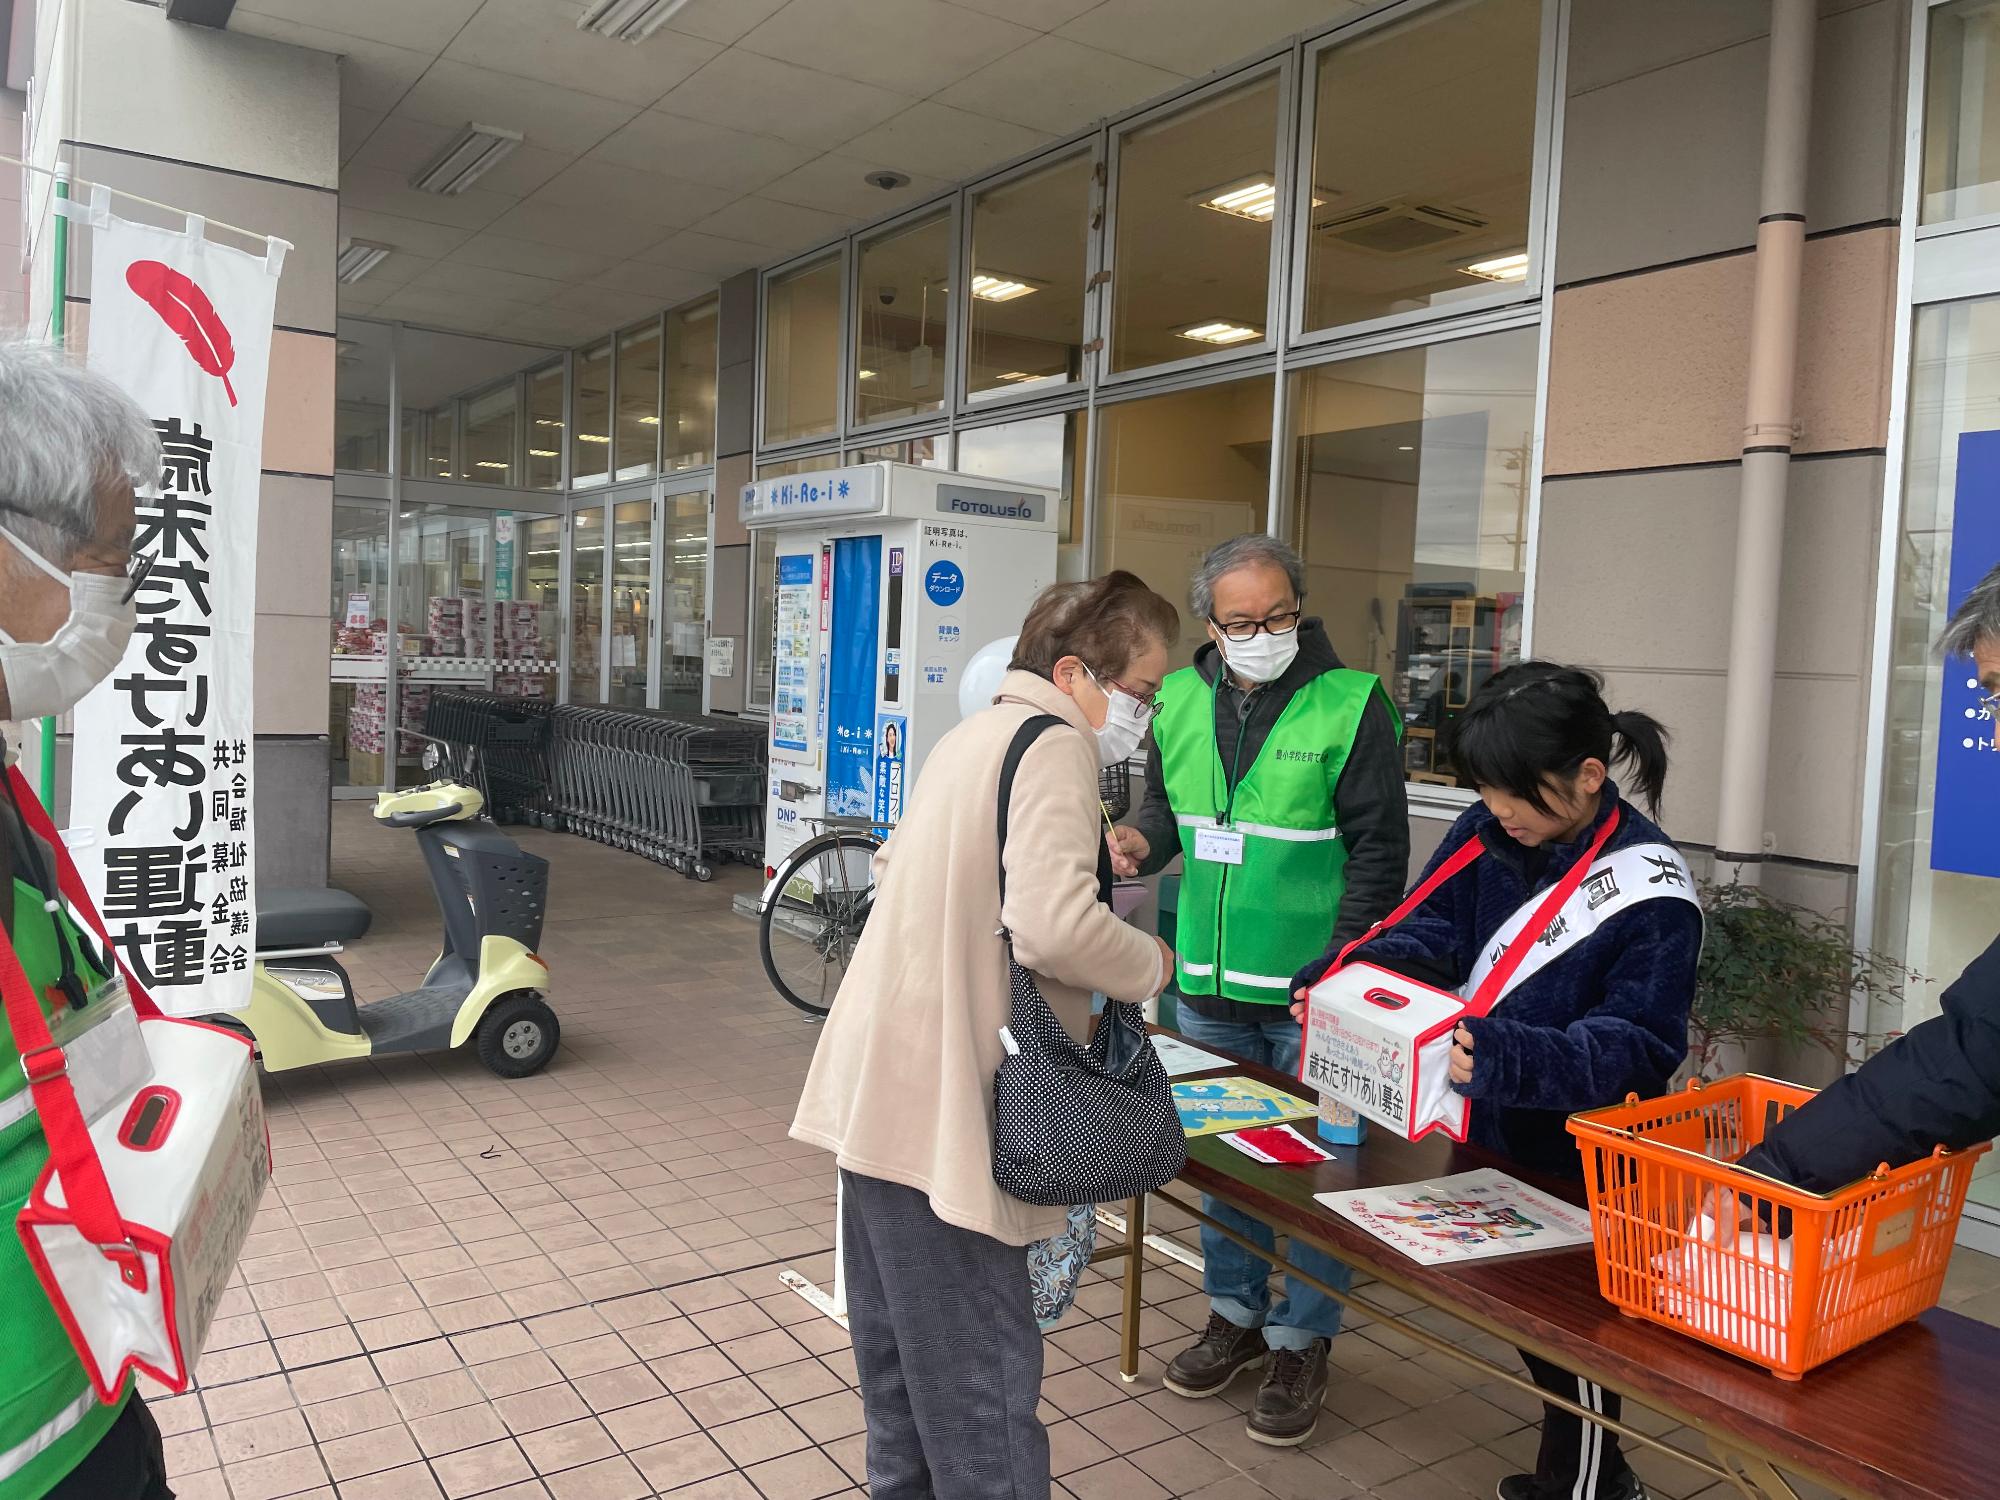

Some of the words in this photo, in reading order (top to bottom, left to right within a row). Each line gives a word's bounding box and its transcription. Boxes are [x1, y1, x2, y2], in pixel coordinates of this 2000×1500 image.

[931, 572, 958, 584] データ
[928, 584, 961, 594] ダウンロード
[938, 625, 960, 636] 背景色
[927, 673, 944, 684] 補正
[777, 807, 797, 823] DNP
[1308, 1051, 1404, 1122] 歳末たすけあい募金
